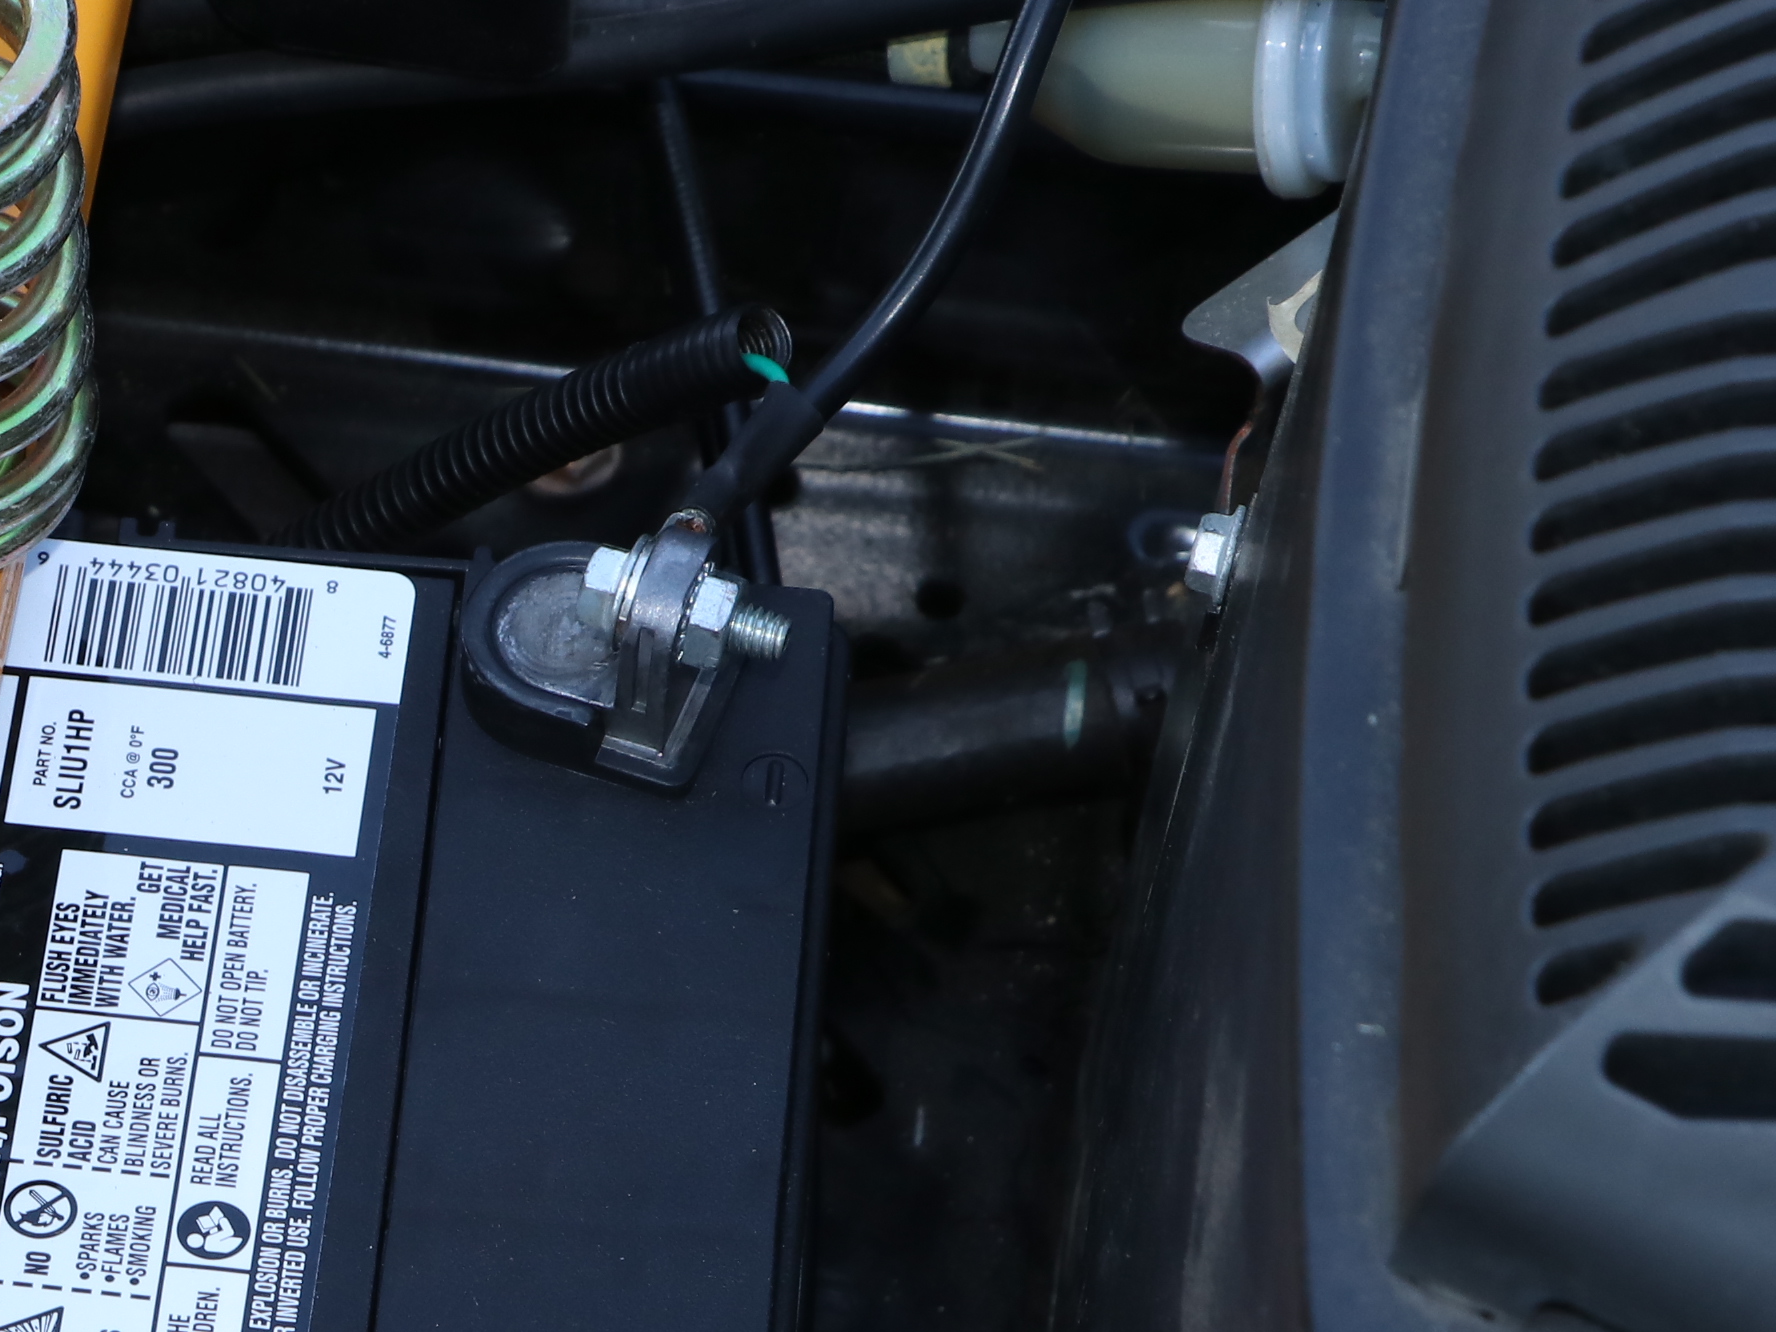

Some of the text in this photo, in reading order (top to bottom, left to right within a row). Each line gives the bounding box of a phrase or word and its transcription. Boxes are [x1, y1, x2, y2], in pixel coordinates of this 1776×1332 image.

[37, 551, 338, 594] 8 40821 03444 6
[378, 616, 394, 659] 4-6877
[32, 725, 56, 786] PART NO.
[53, 709, 94, 810] SLIU1HP
[120, 725, 144, 799] CCA @ 0°F
[146, 748, 179, 789] 300
[322, 758, 346, 794] 12V
[136, 861, 164, 894] GET
[156, 866, 191, 940] MEDICAL
[67, 891, 107, 1006] IMMEDIATELY
[180, 870, 218, 962] HELP FAST.
[301, 892, 334, 977] INCINERATE.
[40, 903, 80, 1003] FLUSH EYES
[94, 898, 135, 1007] WITH WATER.
[210, 884, 256, 1049] DO NOT OPEN BATTERY.
[321, 901, 358, 1008] INSTRUCTIONS.
[235, 970, 267, 1051] DO NOT TIP.
[297, 980, 321, 1001] OR
[282, 1003, 318, 1102] DISASSEMBLE
[310, 1010, 342, 1084] CHARGING
[37, 1075, 74, 1159] SULFURIC
[67, 1120, 96, 1162] ACID
[97, 1081, 130, 1164] CAN CAUSE
[123, 1058, 160, 1167] BLINDNESS OR
[150, 1053, 188, 1170] SEVERE BURNS.
[215, 1074, 252, 1188] INSTRUCTIONS.
[277, 1102, 303, 1135] NOT
[301, 1086, 330, 1146] PROPER
[190, 1114, 222, 1185] READ ALL
[274, 1137, 298, 1160] DO
[291, 1148, 321, 1210] FOLLOW
[264, 1164, 294, 1219] BURNS.
[24, 1252, 51, 1275] NO
[75, 1212, 105, 1271] SPARKS
[101, 1214, 130, 1274] FLAMES
[125, 1206, 156, 1277] SMOKING
[261, 1222, 286, 1244] OR
[286, 1214, 312, 1248] USE.
[248, 1246, 282, 1330] EXPLOSION
[275, 1250, 306, 1323] INVERTED
